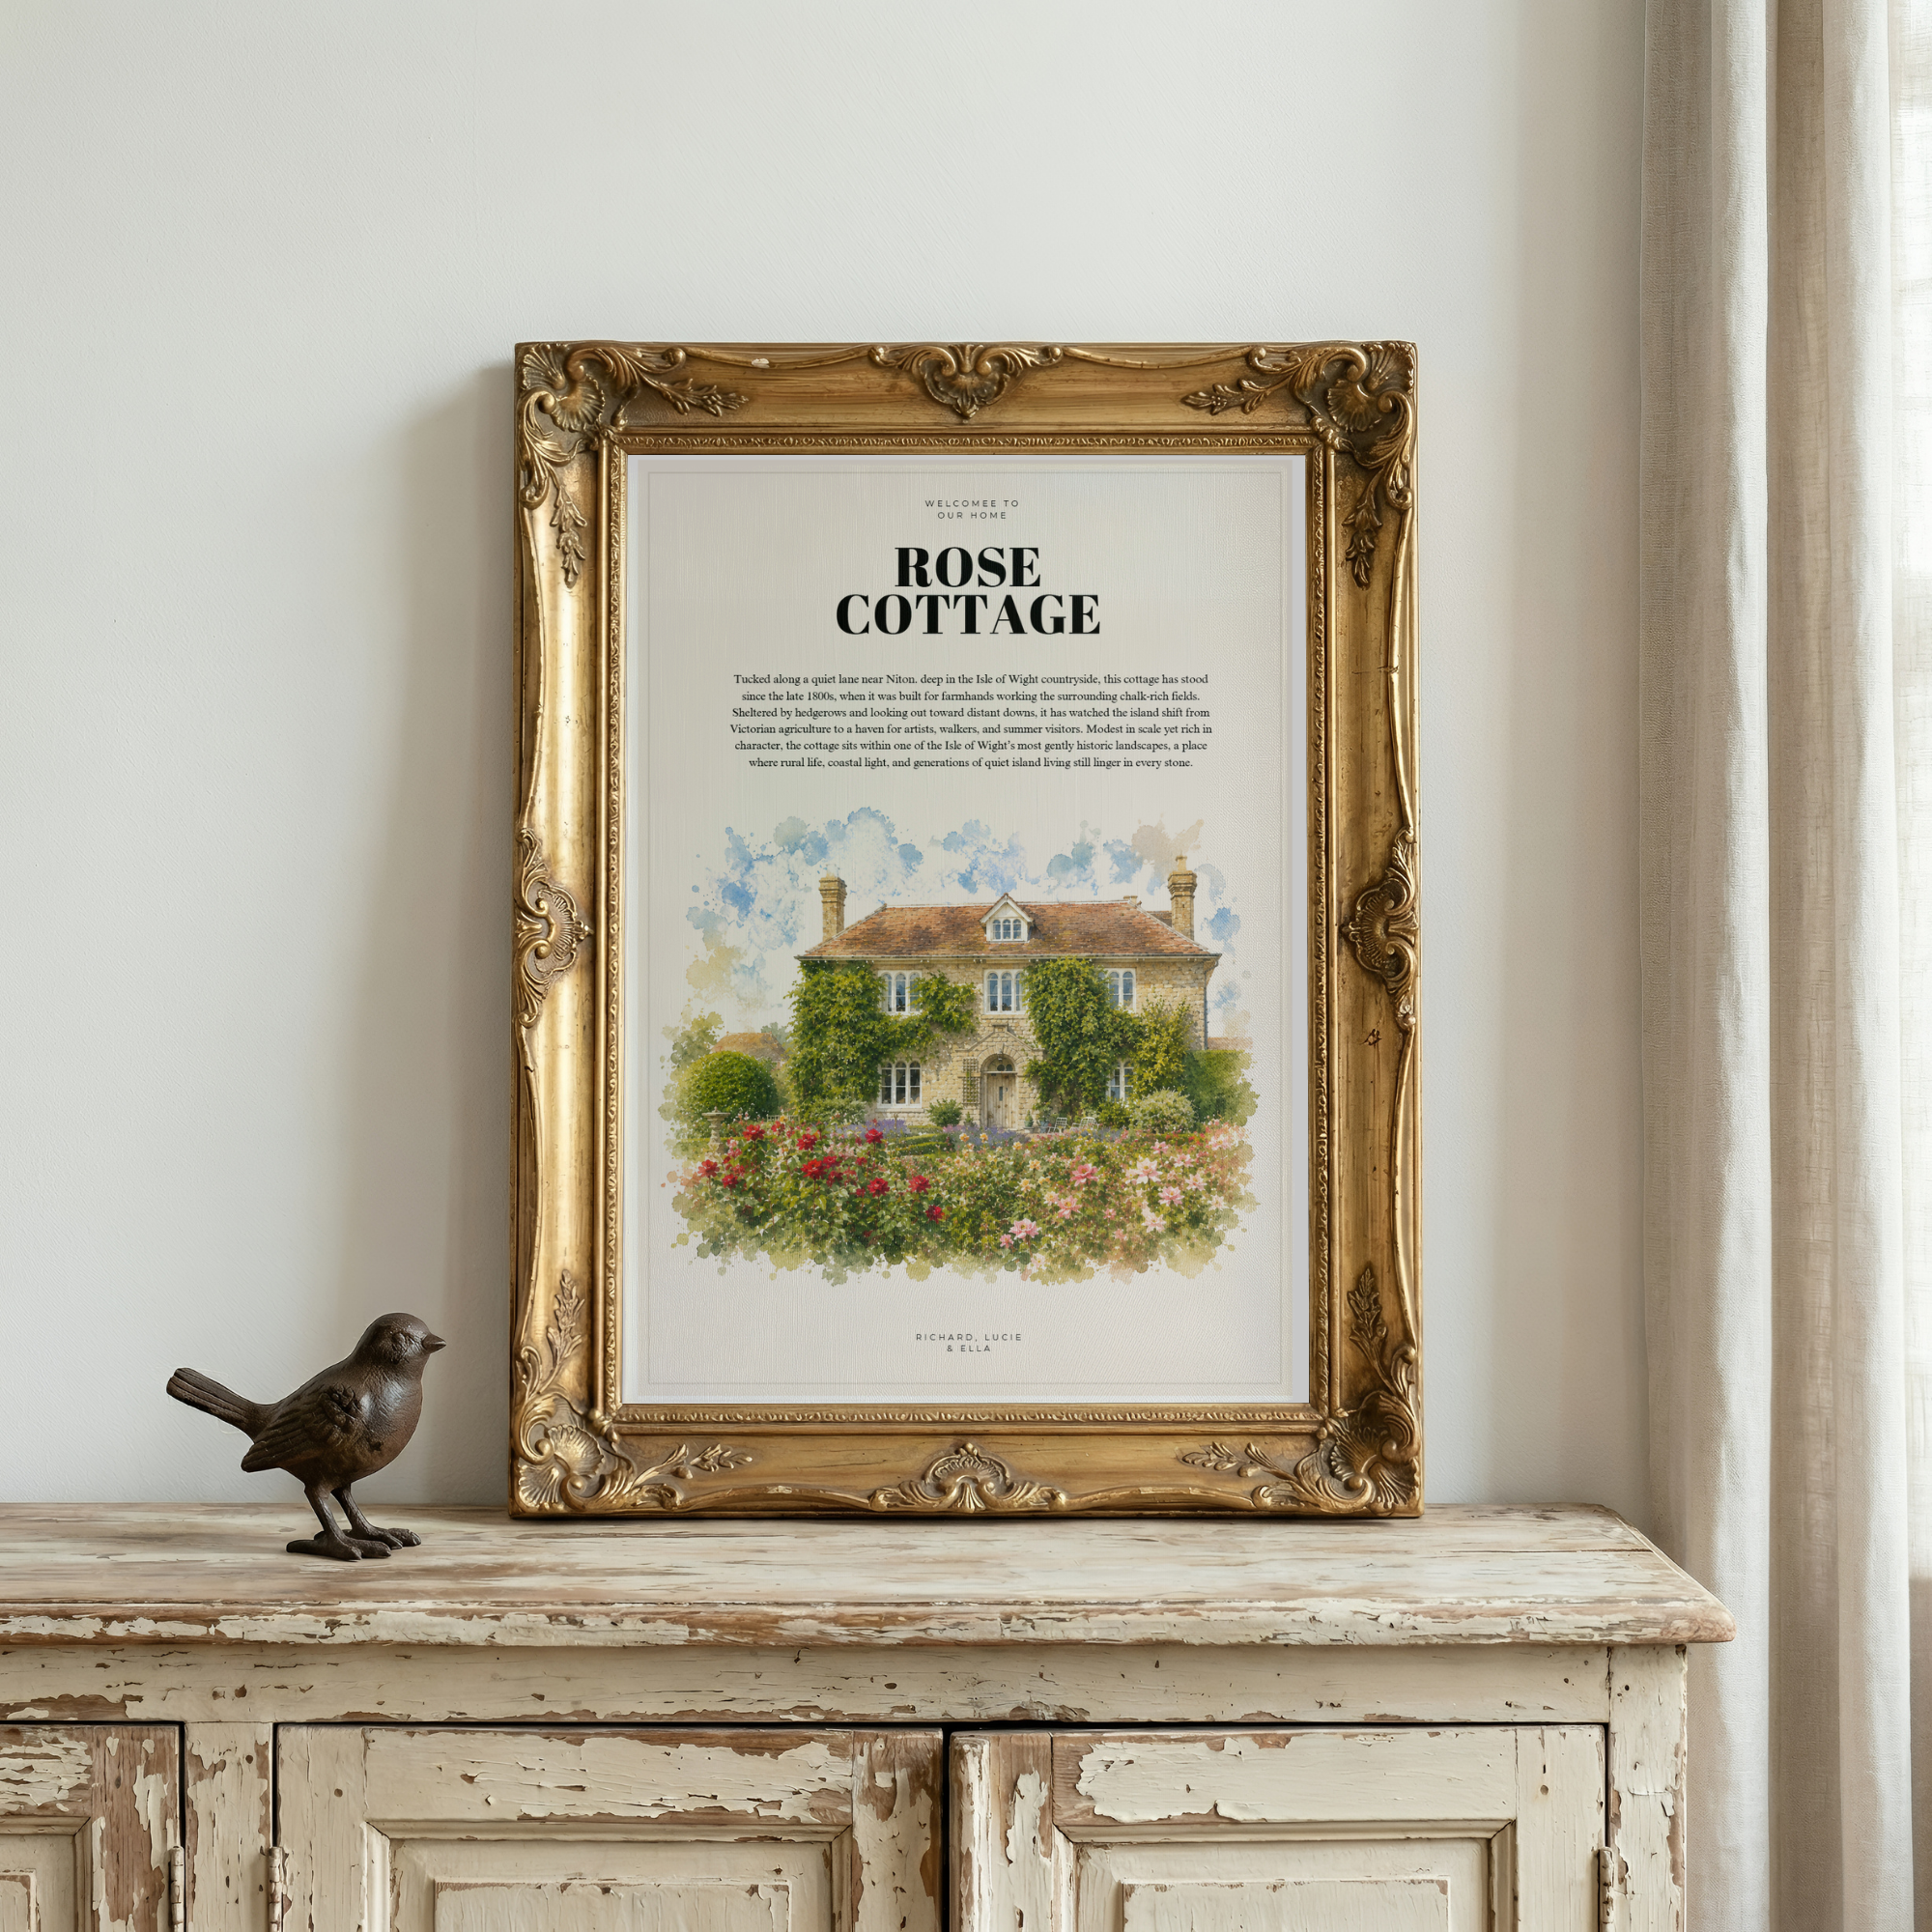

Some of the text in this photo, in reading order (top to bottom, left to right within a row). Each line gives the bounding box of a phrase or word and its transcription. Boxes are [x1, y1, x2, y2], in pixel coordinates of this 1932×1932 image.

[1003, 499, 1019, 508] TO
[937, 511, 1007, 520] OUR HOME
[895, 547, 1040, 587] ROSE
[837, 594, 1100, 635] COTTAGE
[733, 673, 771, 684] Tucked
[773, 673, 802, 687] along
[810, 673, 837, 687] quiet
[838, 673, 860, 684] lane
[920, 673, 944, 687] deep
[945, 673, 956, 684] in
[957, 673, 974, 684] the
[976, 673, 994, 684] Isle
[995, 673, 1008, 684] of
[1008, 673, 1039, 687] Wight
[1040, 673, 1101, 687] countryside,
[1103, 673, 1122, 684] this
[1122, 675, 1160, 687] cottage
[1161, 673, 1179, 684] has
[1180, 673, 1209, 684] stood
[741, 691, 767, 701] since
[768, 691, 784, 701] the
[785, 690, 805, 701] late
[807, 691, 838, 703] 1800s,
[838, 691, 867, 701] when
[867, 692, 875, 701] it
[898, 690, 922, 701] built
[923, 691, 940, 701] for
[941, 691, 995, 701] farmhands
[996, 691, 1038, 704] working
[1039, 691, 1056, 701] the
[1057, 691, 1119, 704] surrounding
[1119, 691, 1170, 701] chalk-rich
[1171, 691, 1201, 701] fields.
[731, 706, 1210, 721] Sheltered by hedgerows and looking out toward distant downs, it has watched the island shift from
[729, 724, 777, 734] Victorian
[778, 723, 832, 737] agriculture
[833, 724, 845, 734] to
[854, 724, 885, 734] haven
[886, 724, 902, 734] for
[903, 724, 937, 736] artists,
[938, 723, 980, 735] walkers,
[981, 724, 1002, 734] and
[1044, 724, 1084, 734] visitors.
[1086, 724, 1123, 734] Modest
[1125, 724, 1136, 734] in
[1137, 723, 1162, 734] scale
[1163, 724, 1179, 737] yet
[1180, 724, 1201, 734] rich
[1202, 724, 1213, 734] in
[734, 740, 783, 753] character,
[785, 740, 802, 751] the
[803, 741, 840, 753] cottage
[841, 740, 858, 751] sits
[859, 740, 892, 751] within
[913, 739, 926, 751] of
[926, 740, 943, 751] the
[945, 739, 962, 751] Isle
[964, 739, 977, 751] of
[1016, 741, 1042, 751] most
[1043, 739, 1075, 753] gently
[1076, 740, 1114, 751] historic
[1115, 739, 1172, 753] landscapes,
[1181, 739, 1208, 753] place
[748, 756, 1194, 770] where rural life, coastal light, and generations of quiet island living still linger in every stone.
[916, 1333, 1022, 1344] RICHARD, LUCIE
[946, 1344, 991, 1352] & ELLA
